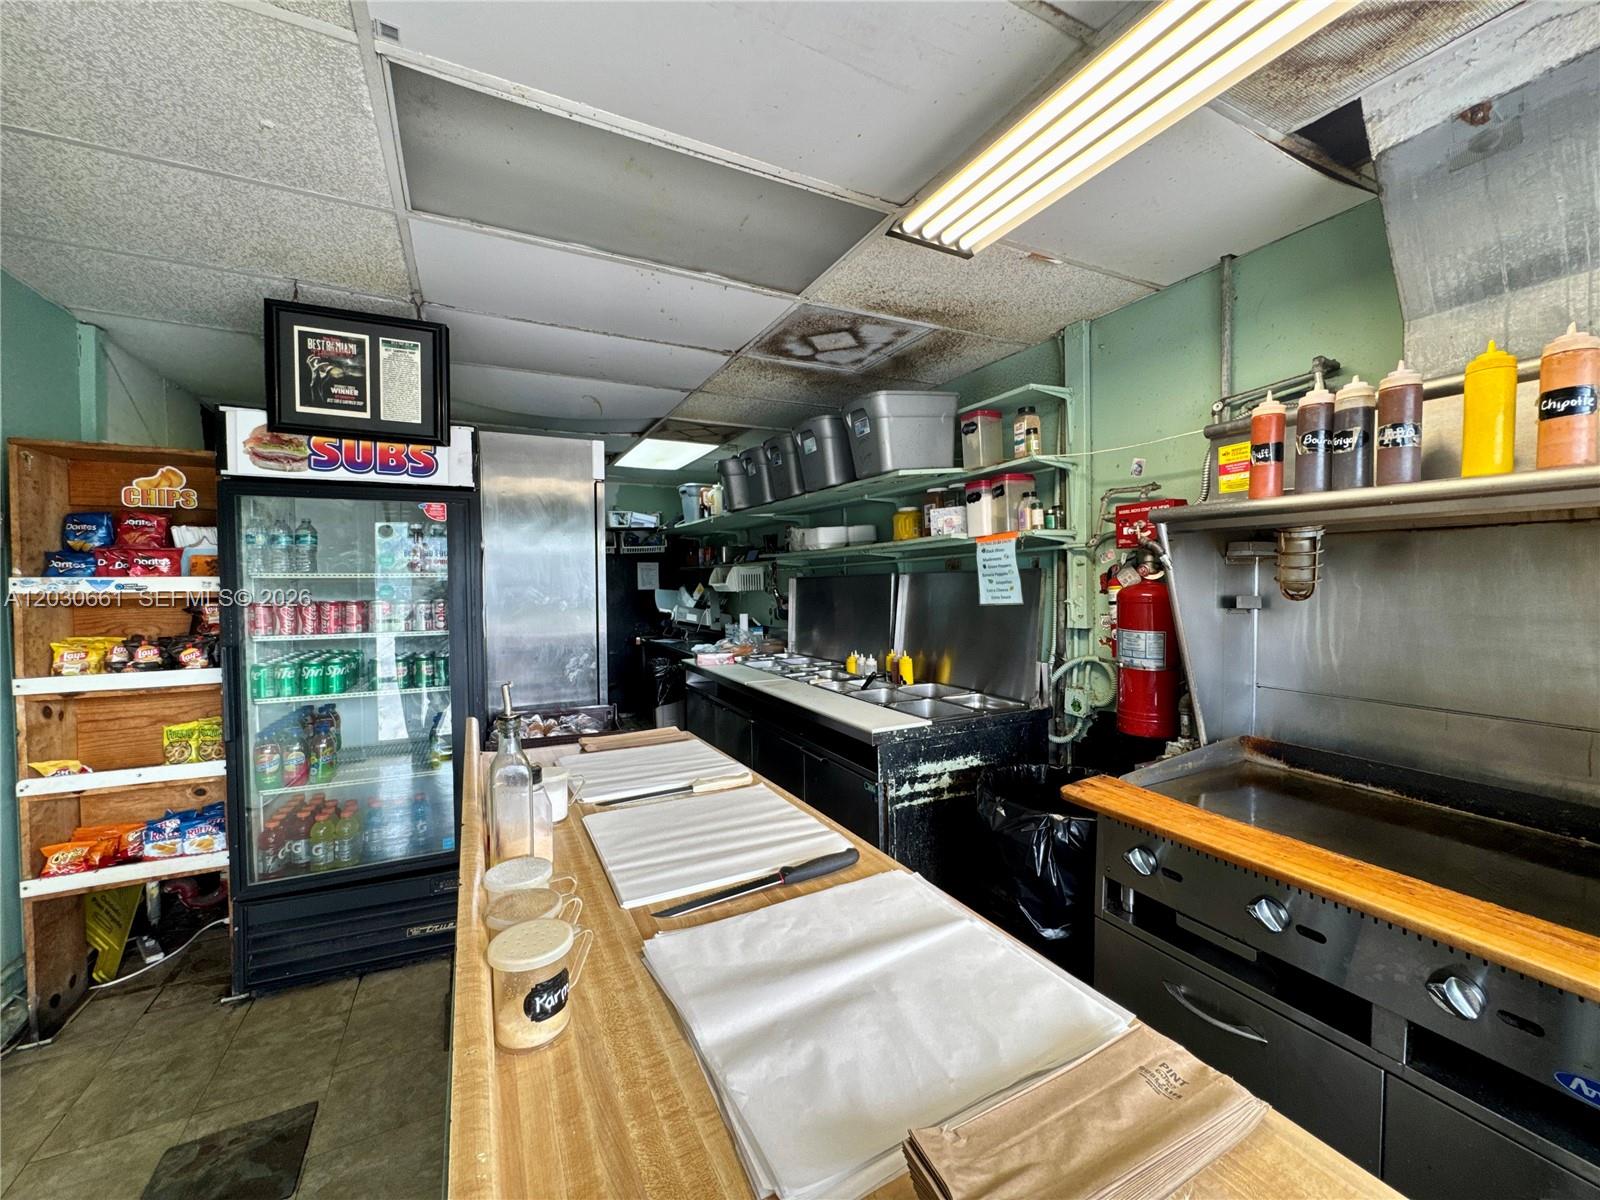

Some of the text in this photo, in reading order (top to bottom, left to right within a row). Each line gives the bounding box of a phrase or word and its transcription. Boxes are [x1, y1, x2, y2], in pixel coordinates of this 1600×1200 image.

[307, 338, 326, 351] BEST
[330, 386, 359, 397] WINNER
[308, 435, 439, 478] SUBS
[122, 486, 199, 509] CHIPS
[66, 523, 97, 531] Doritos
[1159, 1062, 1190, 1087] PINT
